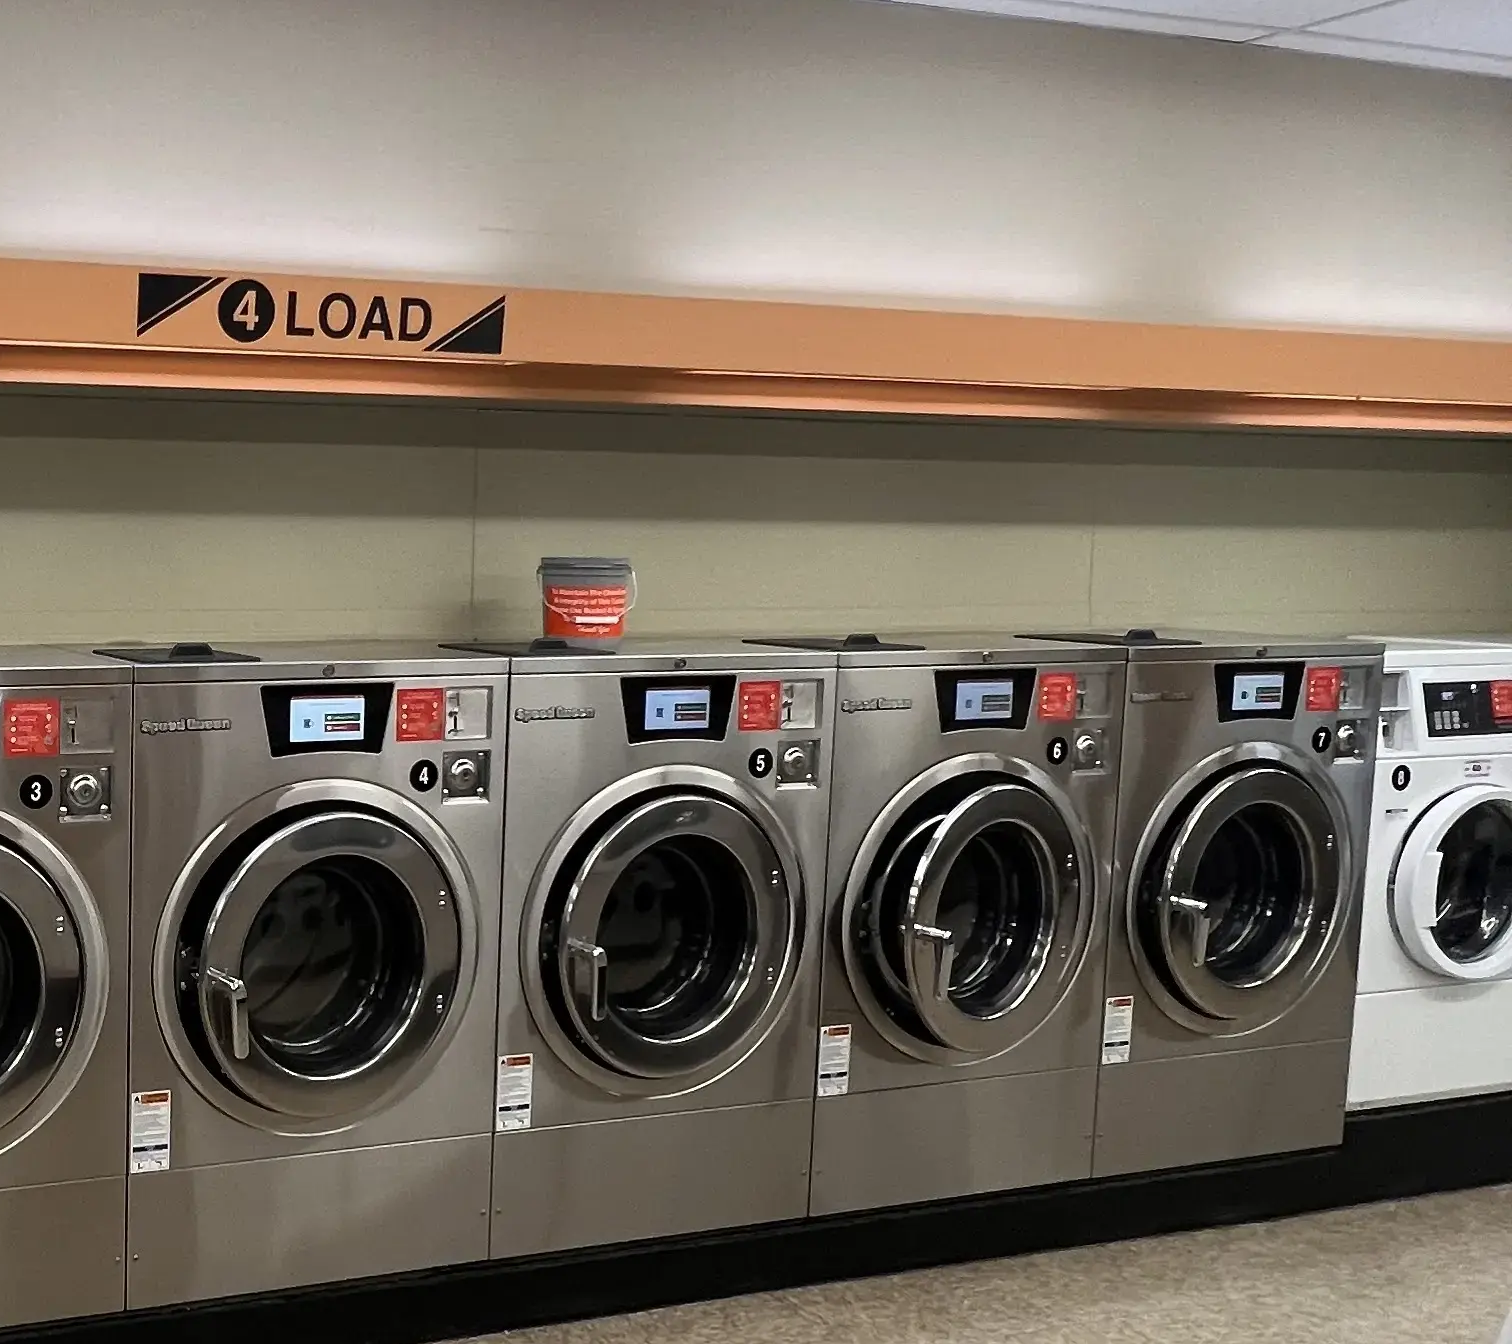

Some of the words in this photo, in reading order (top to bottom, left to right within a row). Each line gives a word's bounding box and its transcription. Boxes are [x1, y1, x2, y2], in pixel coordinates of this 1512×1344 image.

[231, 290, 260, 332] 4
[285, 290, 433, 342] LOAD
[1318, 732, 1326, 748] 7
[1053, 742, 1062, 759] 6
[756, 754, 766, 772] 5
[419, 766, 429, 785] 4
[1397, 770, 1405, 786] 8
[30, 781, 42, 802] 3
